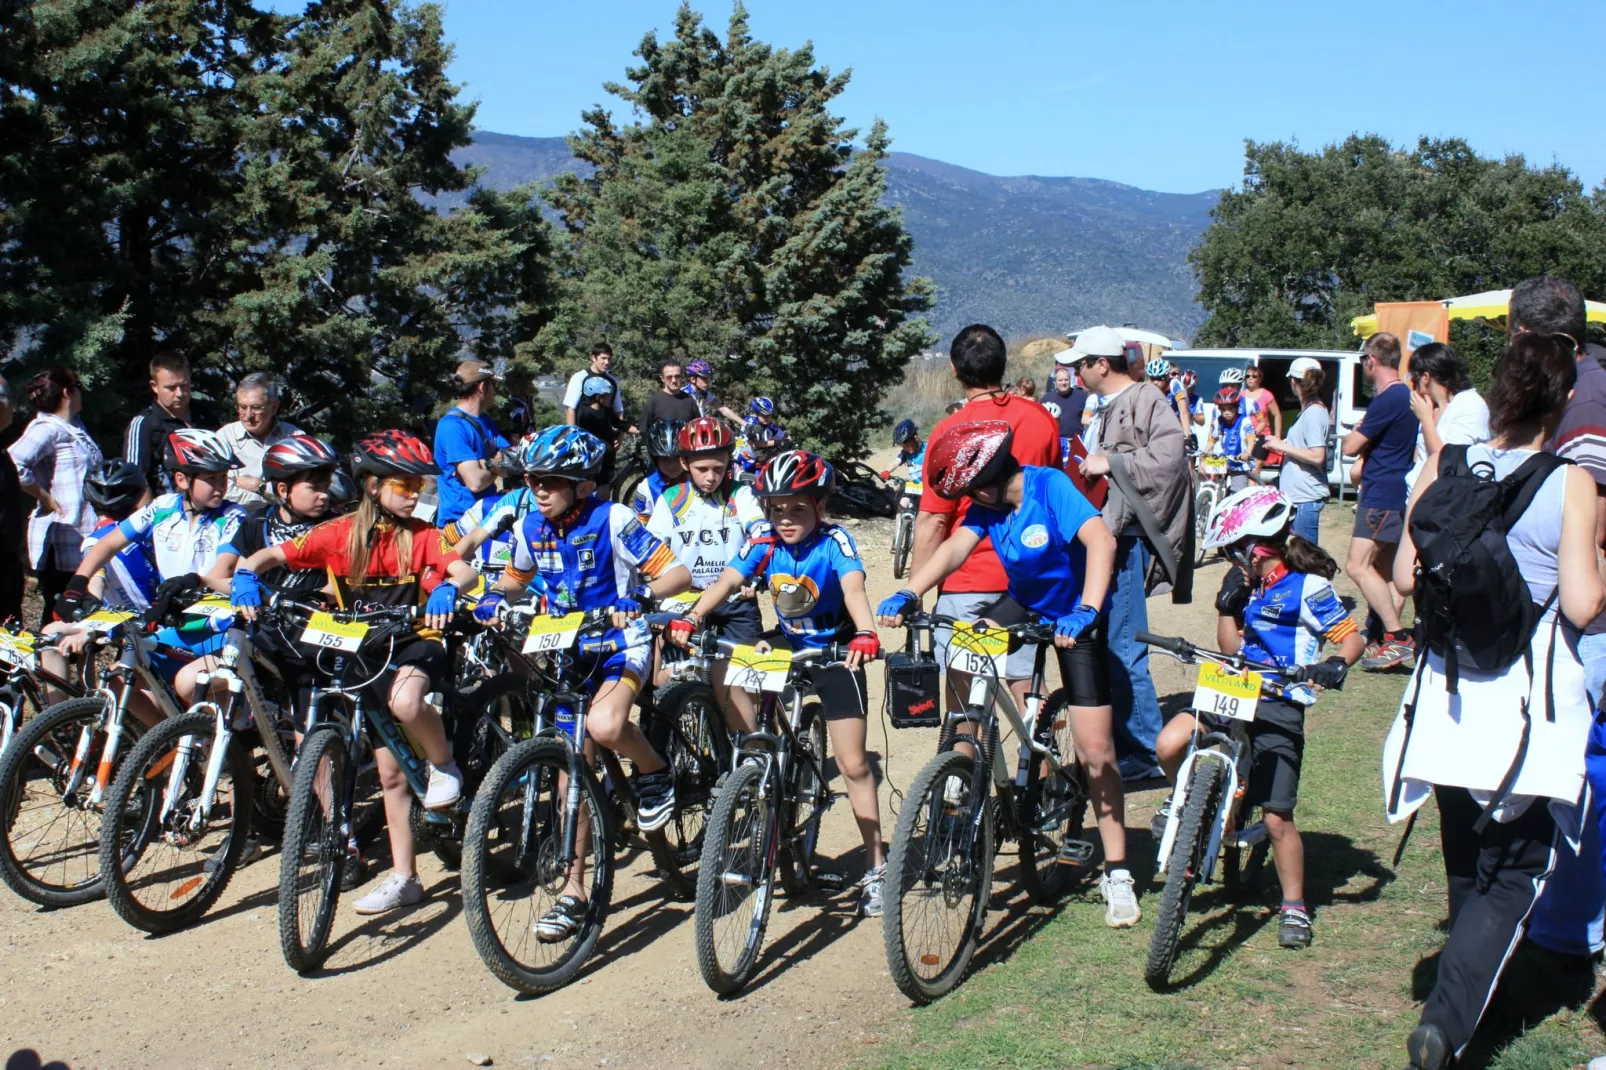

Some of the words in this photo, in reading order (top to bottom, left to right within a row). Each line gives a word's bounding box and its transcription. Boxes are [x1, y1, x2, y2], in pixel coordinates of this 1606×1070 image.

[203, 605, 218, 614] 151
[318, 633, 344, 648] 155
[539, 633, 561, 649] 150
[965, 653, 989, 674] 152
[744, 671, 768, 686] 147
[1213, 694, 1239, 716] 149
